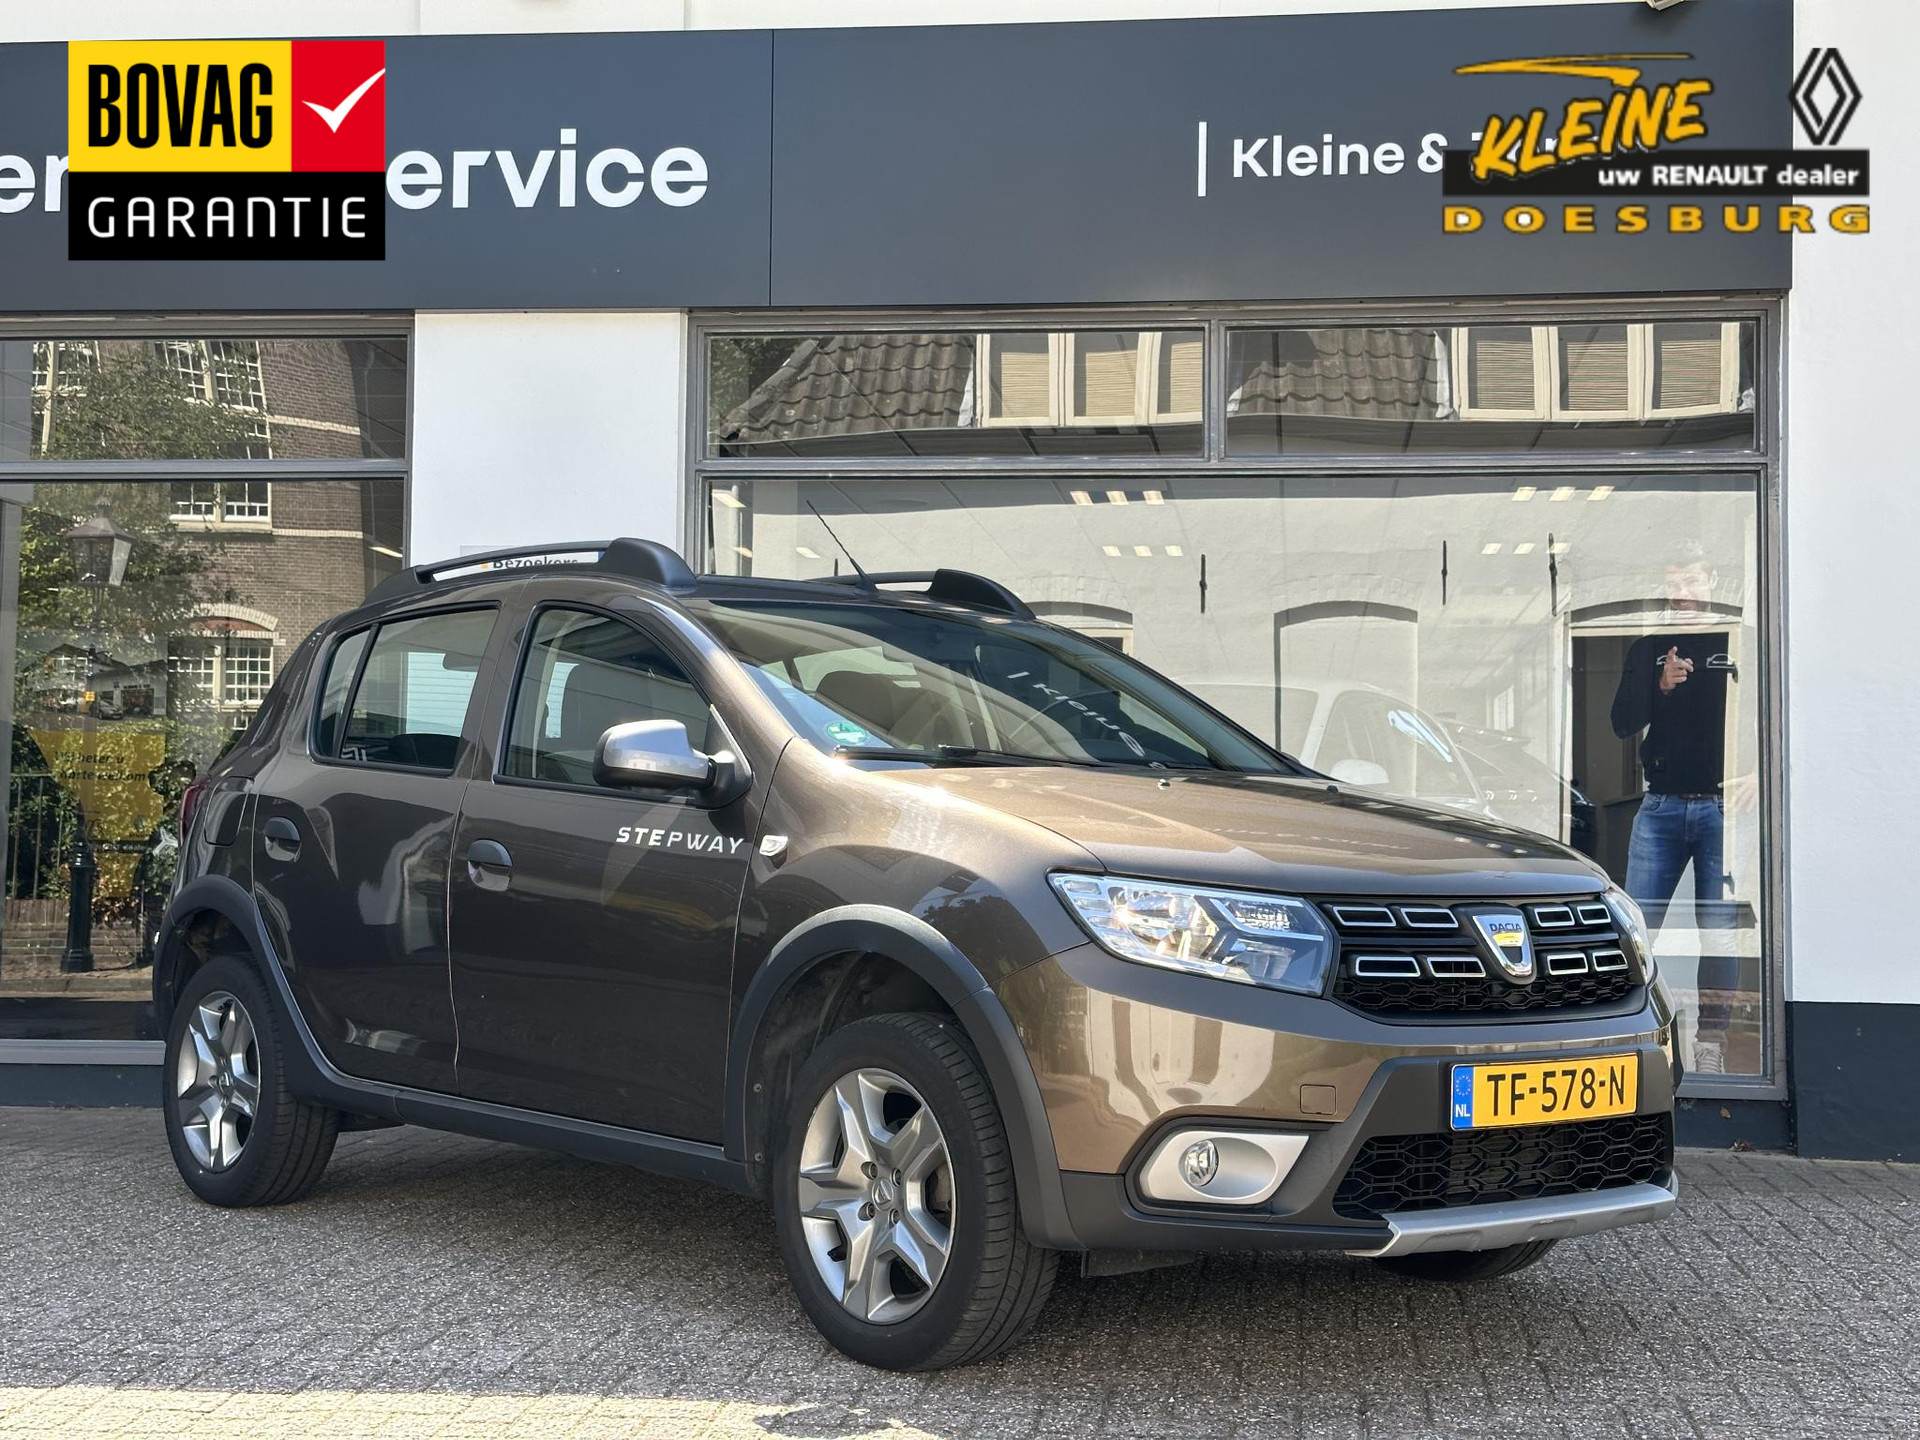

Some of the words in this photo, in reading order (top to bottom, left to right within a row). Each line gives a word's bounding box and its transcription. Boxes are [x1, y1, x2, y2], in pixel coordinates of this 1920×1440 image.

[385, 128, 708, 210] ervice
[1232, 133, 1405, 178] Kleine
[1417, 132, 1449, 173] &
[615, 826, 745, 855] STEPWAY
[1489, 922, 1523, 932] DACIA
[1455, 1103, 1471, 1118] NL
[1486, 1064, 1626, 1117] TF-578-N
